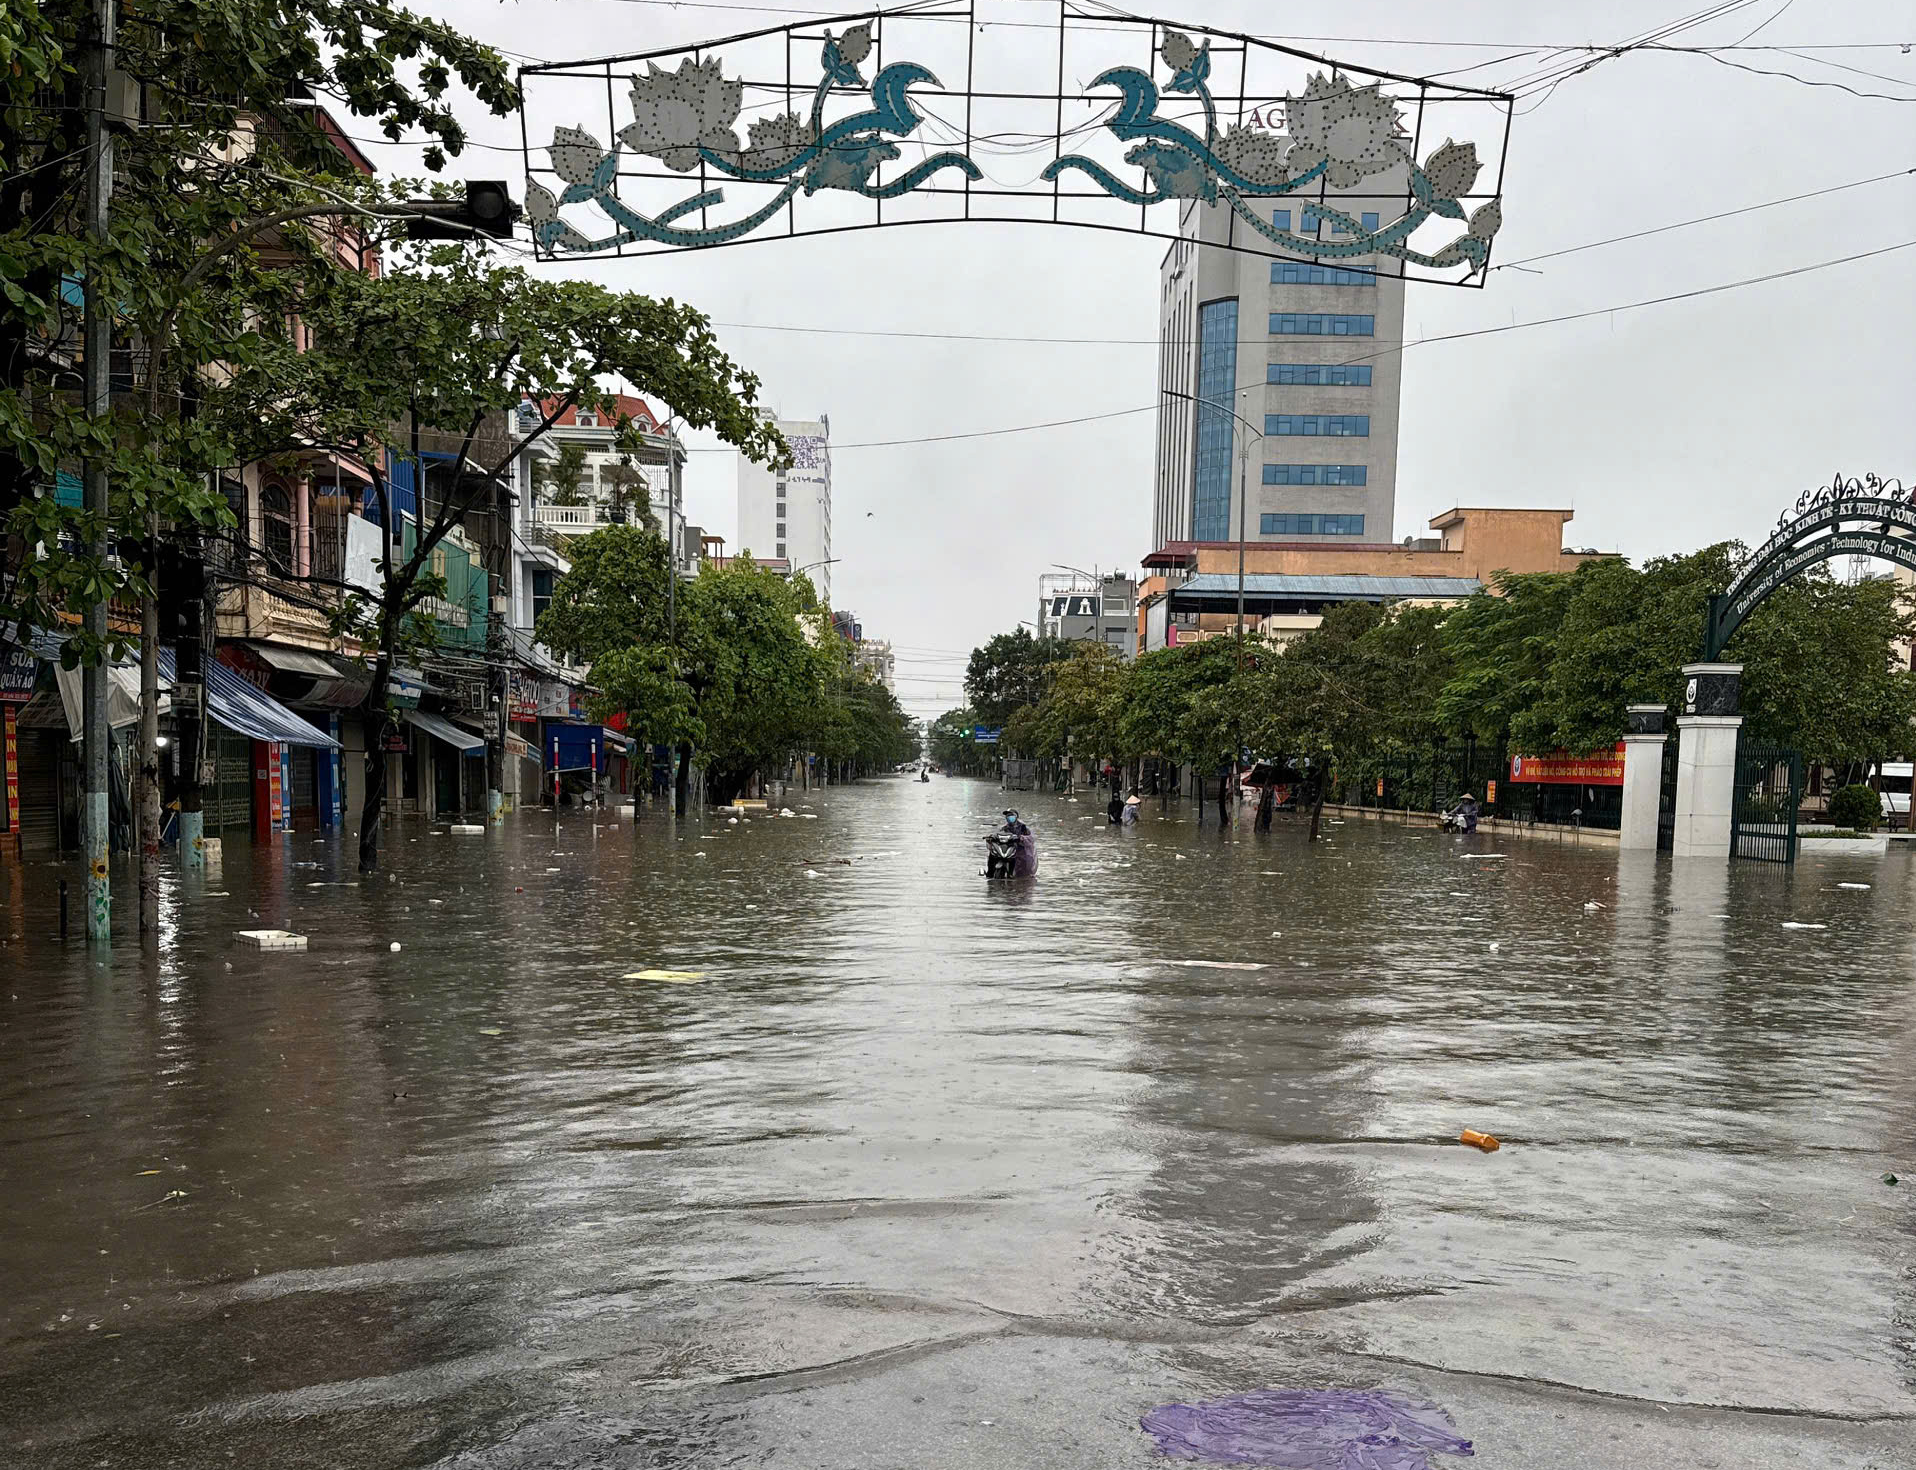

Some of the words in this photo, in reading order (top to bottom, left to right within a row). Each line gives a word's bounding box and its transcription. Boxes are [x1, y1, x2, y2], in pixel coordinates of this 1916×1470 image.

[1774, 527, 1793, 548] HỌC
[1794, 511, 1820, 534] KINH
[1820, 504, 1834, 518] TẾ
[1855, 501, 1892, 519] THUẬT
[1736, 573, 1774, 614] University
[1774, 563, 1784, 579] of
[1784, 542, 1826, 571] Economics
[1830, 536, 1880, 554] Technology
[1880, 539, 1896, 555] for
[21, 671, 34, 689] ÁO
